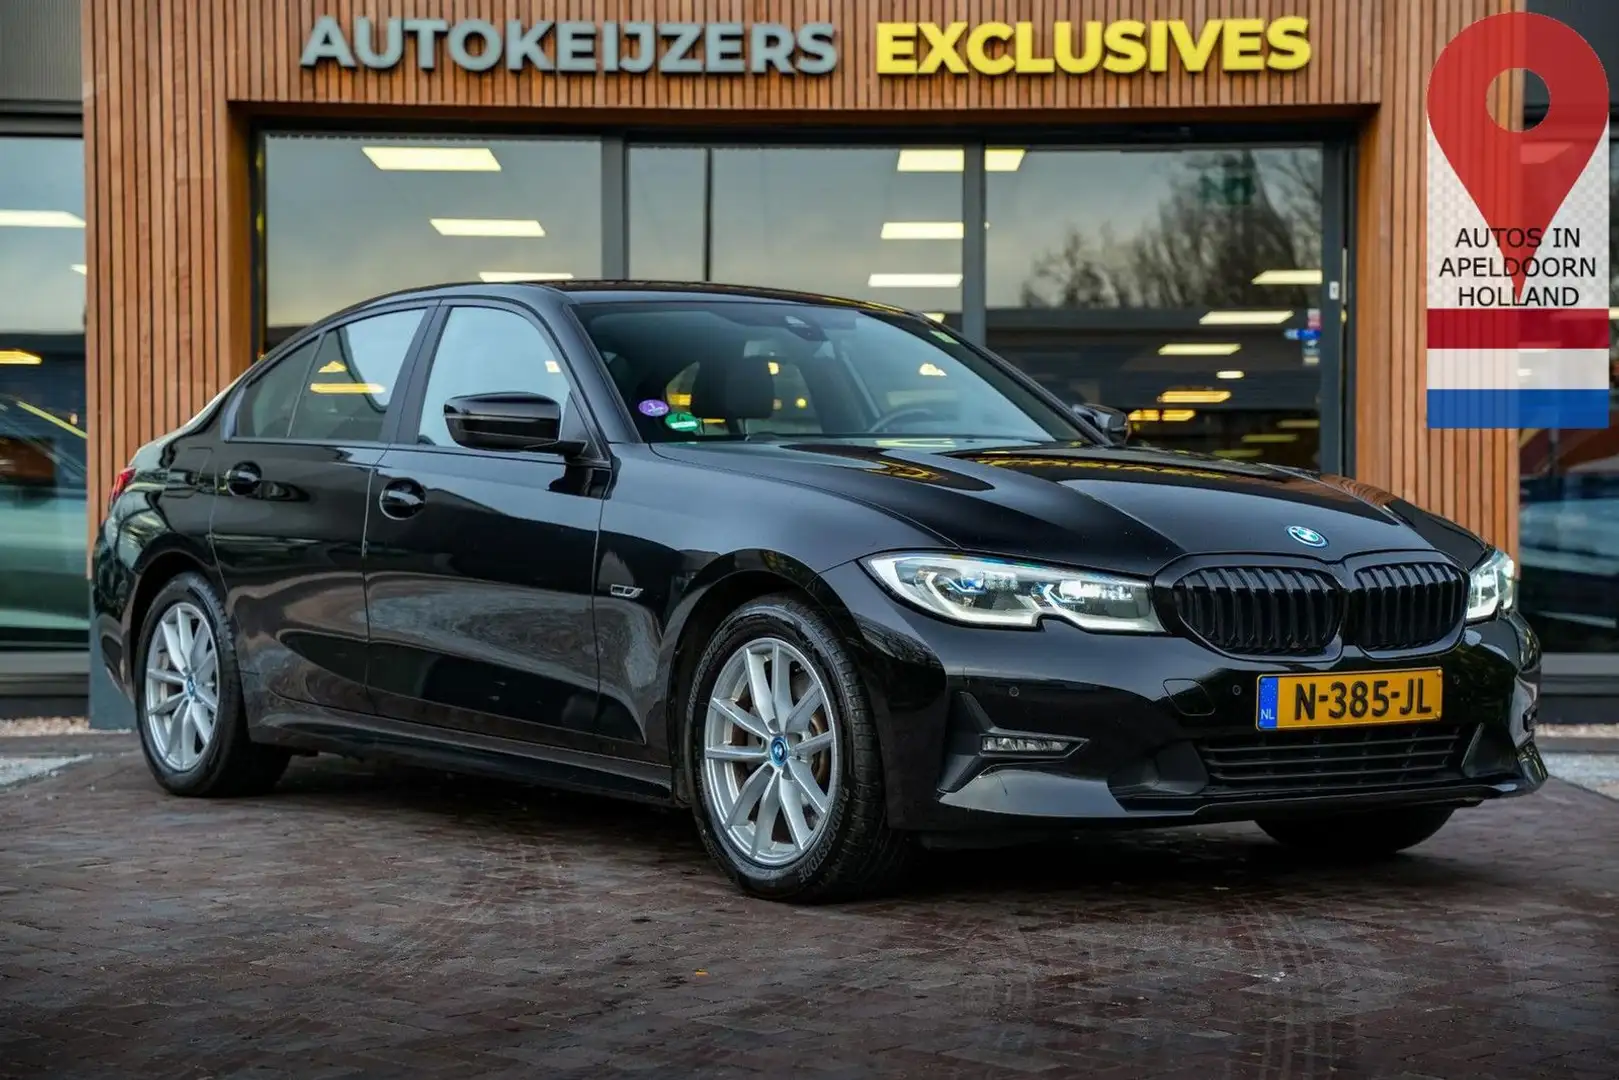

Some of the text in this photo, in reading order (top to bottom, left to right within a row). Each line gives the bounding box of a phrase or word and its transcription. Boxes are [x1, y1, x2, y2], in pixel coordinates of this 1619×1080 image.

[300, 15, 1312, 75] AUTOKEIJZERS EXCLUSIVES
[1260, 708, 1276, 720] NL
[1294, 678, 1432, 721] N-385-JL
